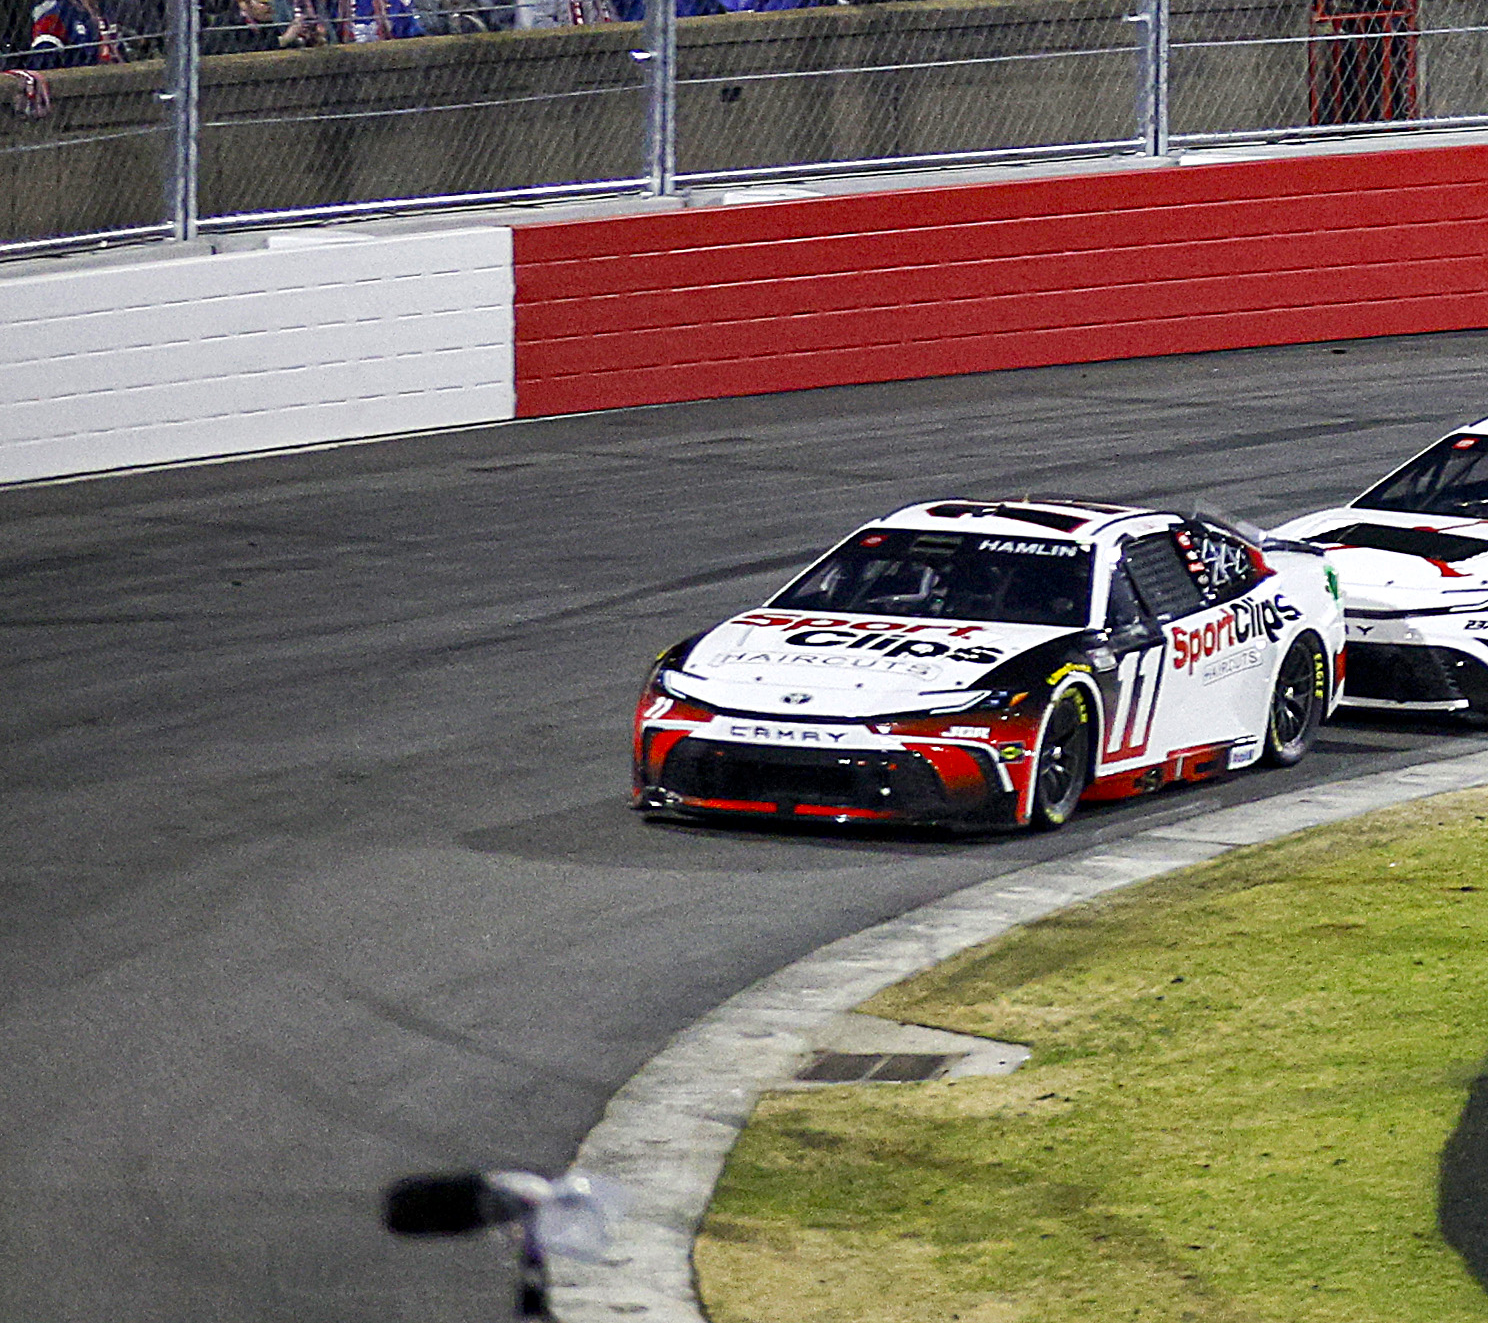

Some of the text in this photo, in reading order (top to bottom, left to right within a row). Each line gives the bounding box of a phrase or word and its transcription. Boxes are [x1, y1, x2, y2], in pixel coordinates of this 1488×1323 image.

[979, 538, 1078, 559] HAMLIN
[731, 613, 985, 640] Sport
[785, 630, 1005, 665] Clips
[722, 651, 933, 678] HAIRCUTS
[1107, 645, 1162, 753] 11
